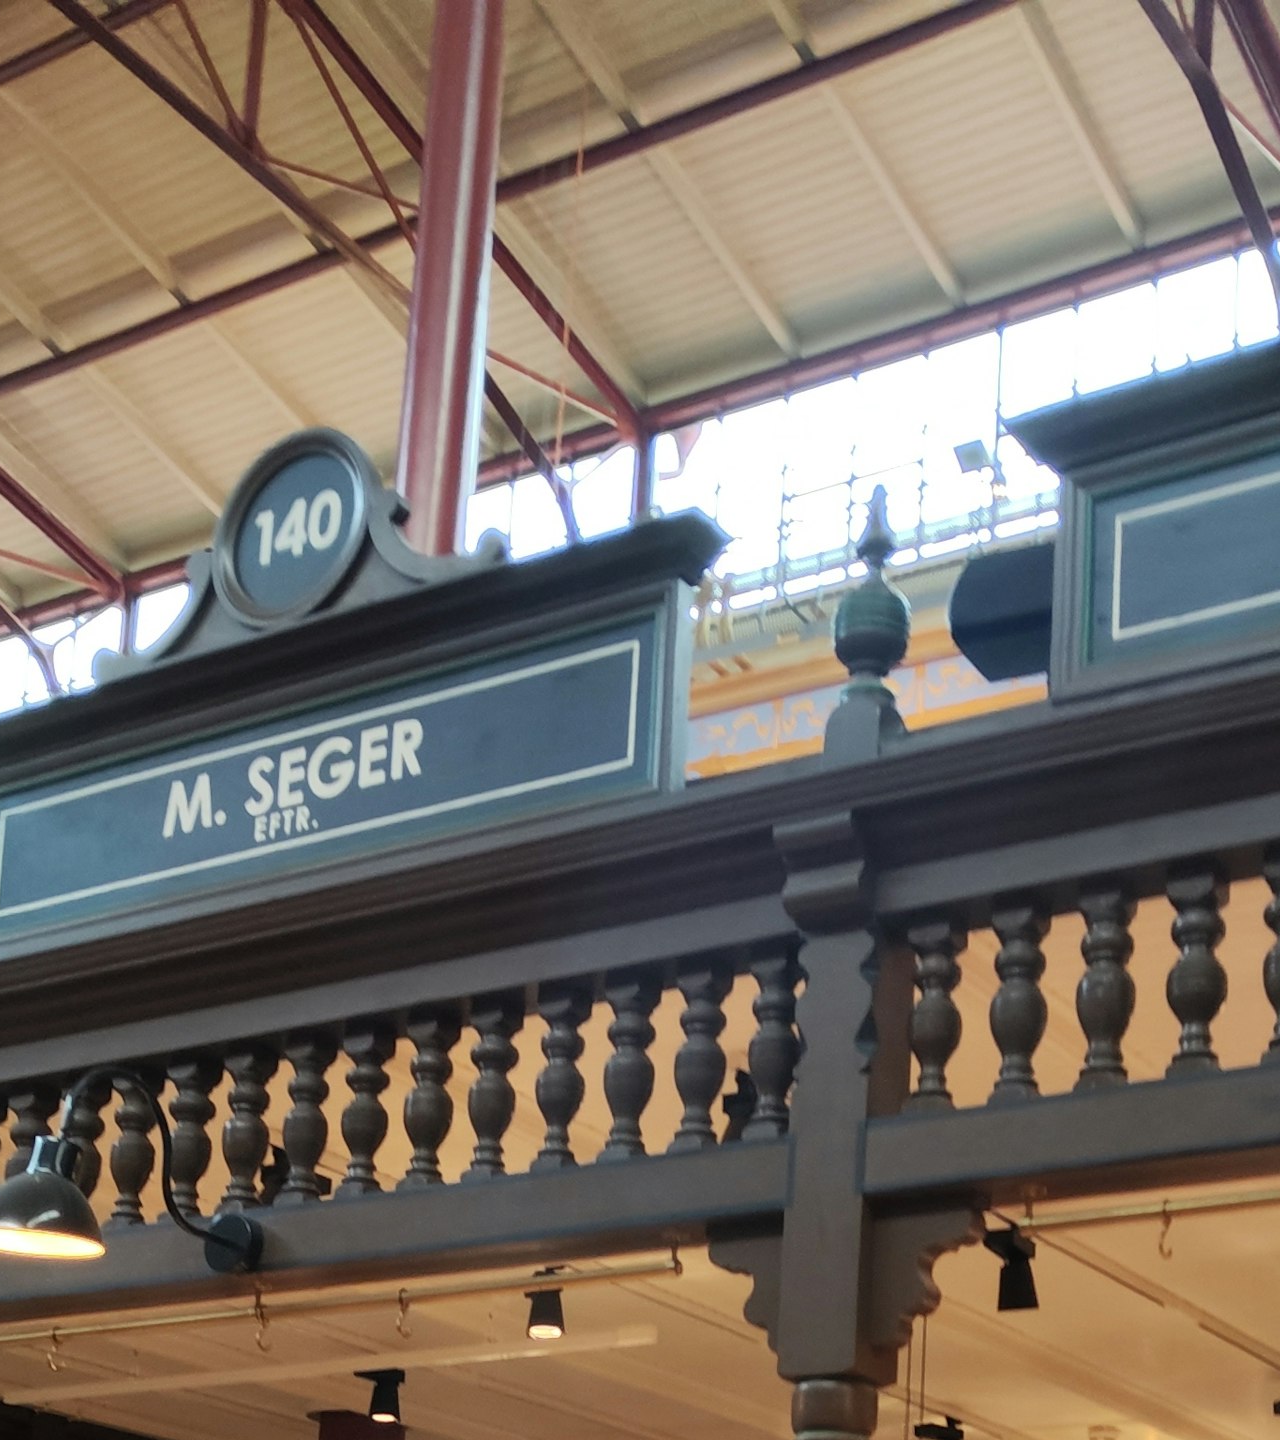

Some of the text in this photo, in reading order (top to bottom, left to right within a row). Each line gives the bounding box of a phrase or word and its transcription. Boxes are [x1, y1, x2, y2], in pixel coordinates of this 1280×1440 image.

[255, 489, 342, 567] 140
[163, 718, 422, 838] M. SEGER
[254, 808, 318, 843] EFTR.
